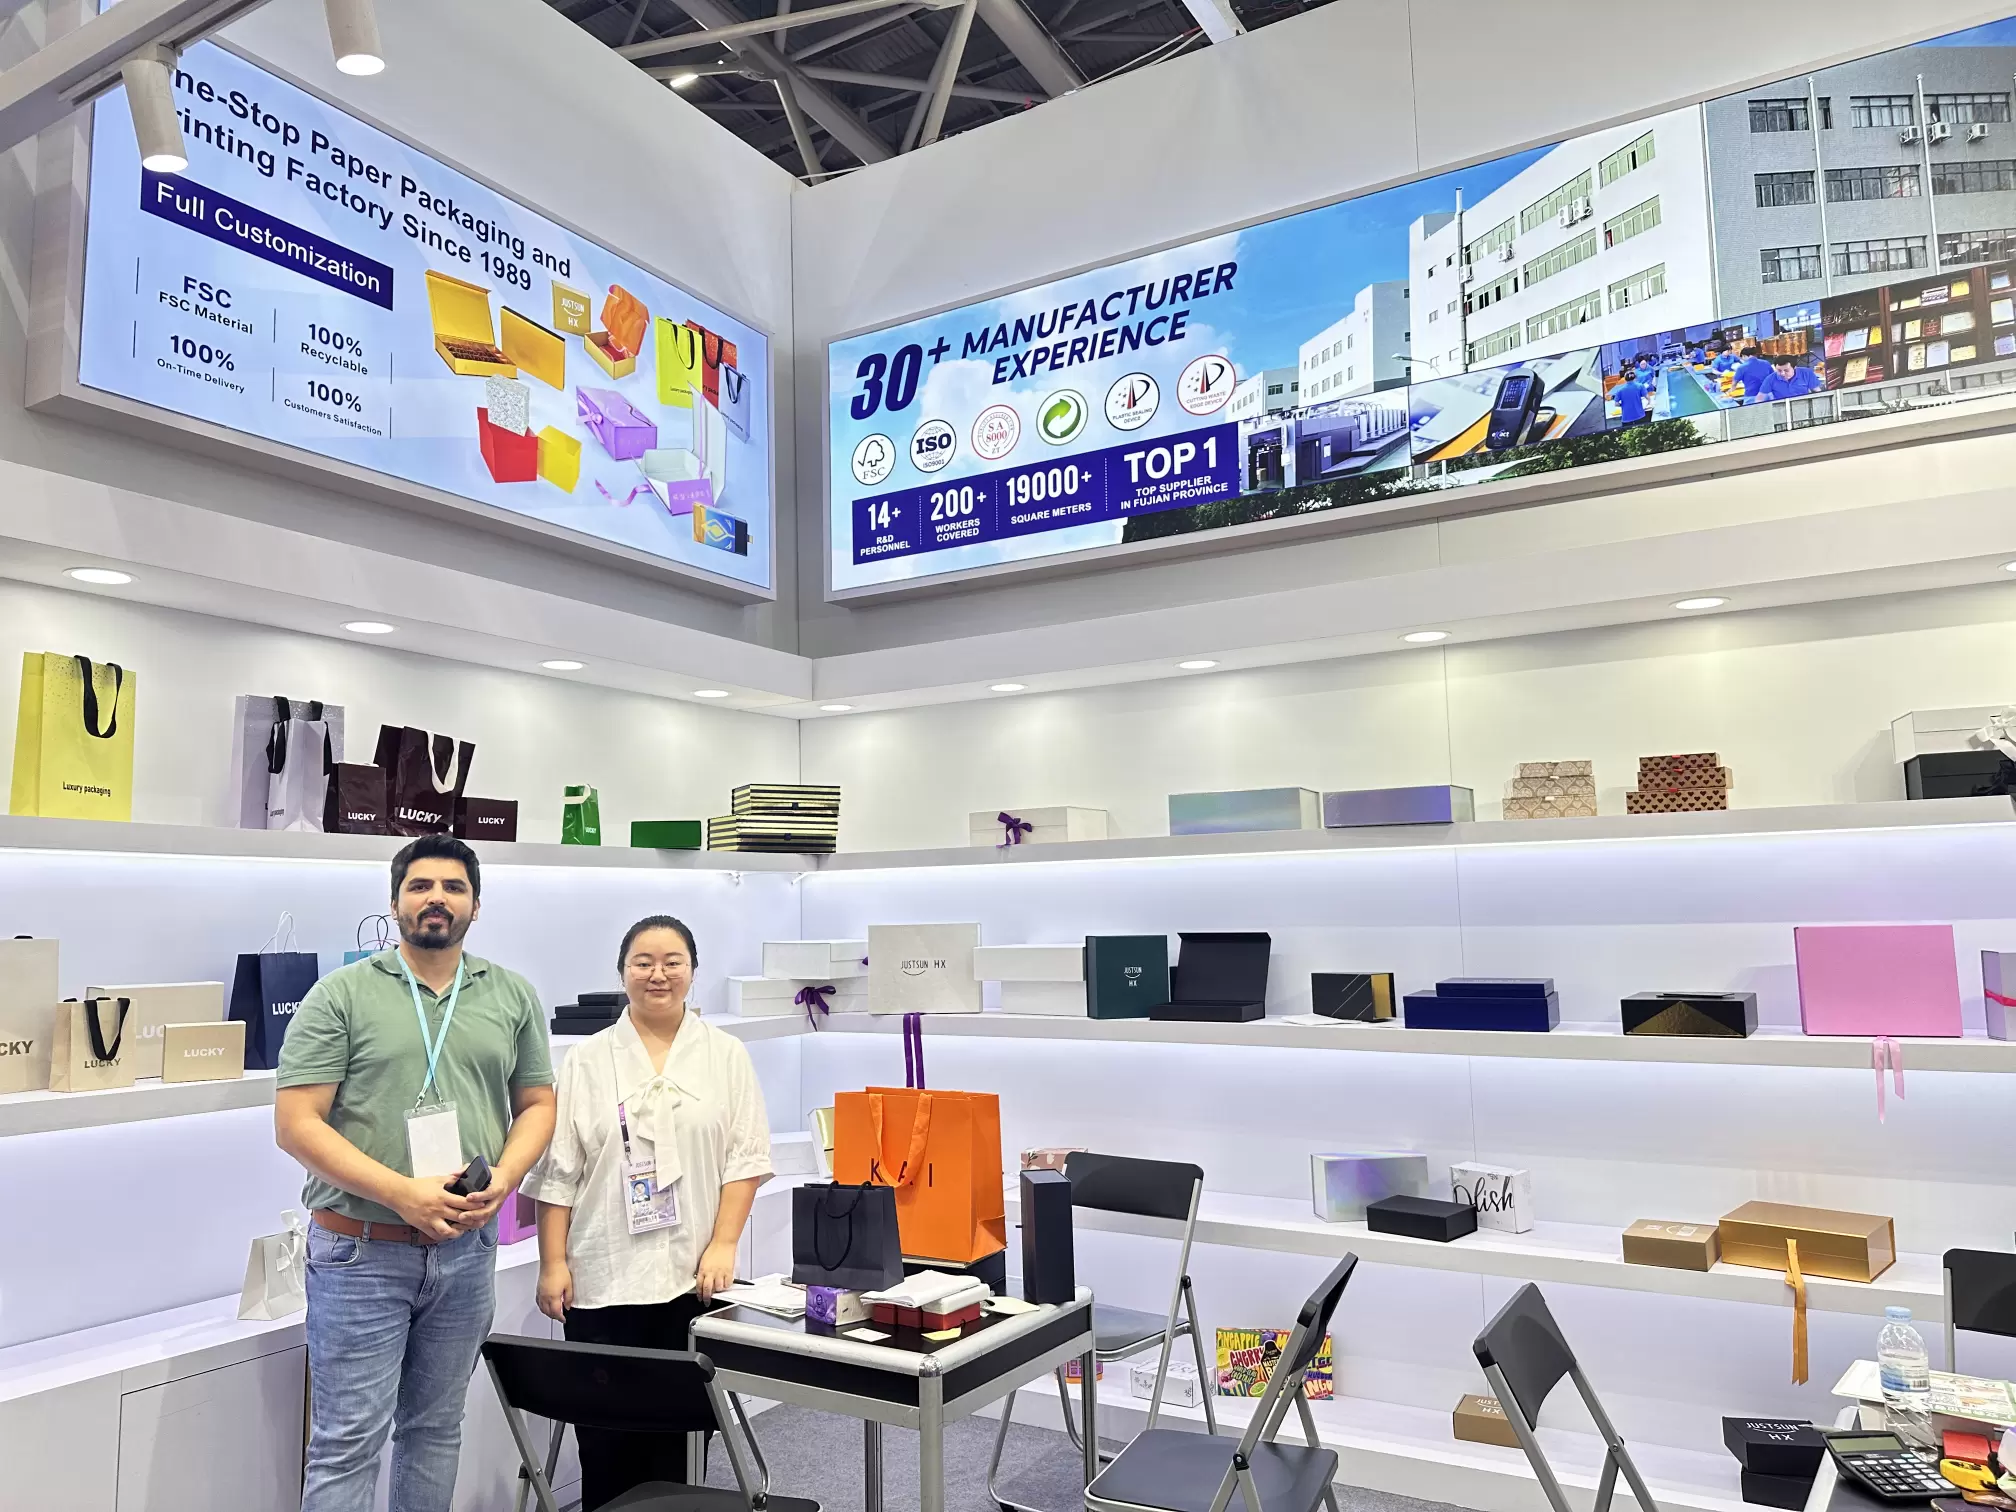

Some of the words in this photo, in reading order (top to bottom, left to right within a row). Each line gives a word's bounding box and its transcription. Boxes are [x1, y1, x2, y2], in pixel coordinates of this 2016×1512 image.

[175, 68, 300, 146] ne-Stop
[311, 130, 392, 190] Paper
[401, 175, 525, 261] Packaging
[532, 246, 571, 278] and
[176, 107, 275, 178] inting
[286, 157, 394, 231] Factory
[403, 213, 472, 263] Since
[480, 251, 532, 291] 1989
[157, 181, 205, 221] Full
[214, 208, 381, 293] Customization
[183, 275, 233, 309] FSC
[158, 291, 190, 312] FSC
[194, 304, 253, 335] Material
[961, 261, 1238, 360] MANUFACTURER
[308, 323, 363, 358] 100%
[992, 310, 1190, 386] EXPERIENCE
[170, 334, 235, 373] 100%
[300, 342, 369, 375] Recyclable
[156, 357, 202, 380] On-Time
[204, 372, 245, 395] Delivery
[307, 380, 363, 413] 100%
[283, 397, 332, 420] Customers
[333, 413, 383, 437] Satisfaction
[916, 433, 952, 455] ISO
[1123, 441, 1196, 484] TOP
[1203, 436, 1217, 469] 1
[863, 467, 886, 480] FSC
[1006, 464, 1092, 507] 19000+
[1120, 500, 1131, 510] IN
[1133, 494, 1171, 508] FUJIAN
[1173, 482, 1229, 500] PROVINCE
[1136, 487, 1158, 498] TOP
[1159, 475, 1212, 494] SUPPLIER
[930, 485, 987, 521] 200+
[1010, 510, 1050, 525] SQUARE
[1052, 502, 1092, 517] METERS
[867, 501, 902, 531] 14+
[935, 518, 980, 533] WORKERS
[876, 534, 894, 545] R&D
[936, 527, 980, 542] COVERED
[860, 540, 911, 556] PERSONNEL
[62, 781, 83, 794] Luxury
[83, 785, 112, 798] packaging
[347, 811, 377, 821] LUCKY
[399, 806, 443, 825] LUCKY
[478, 816, 506, 826] LUCKY
[901, 959, 929, 970] JUSTSUN
[934, 959, 947, 969] HX
[272, 1001, 301, 1016] LUCK
[135, 1024, 165, 1040] LUC
[0, 1040, 34, 1057] CKY
[184, 1047, 226, 1058] LUCKY
[1217, 1330, 1261, 1351] PINEAPPLE
[1476, 1398, 1501, 1406] JUST
[1482, 1407, 1501, 1415] HX
[1746, 1422, 1800, 1431] JUSTSUN
[1768, 1433, 1795, 1441] HX
